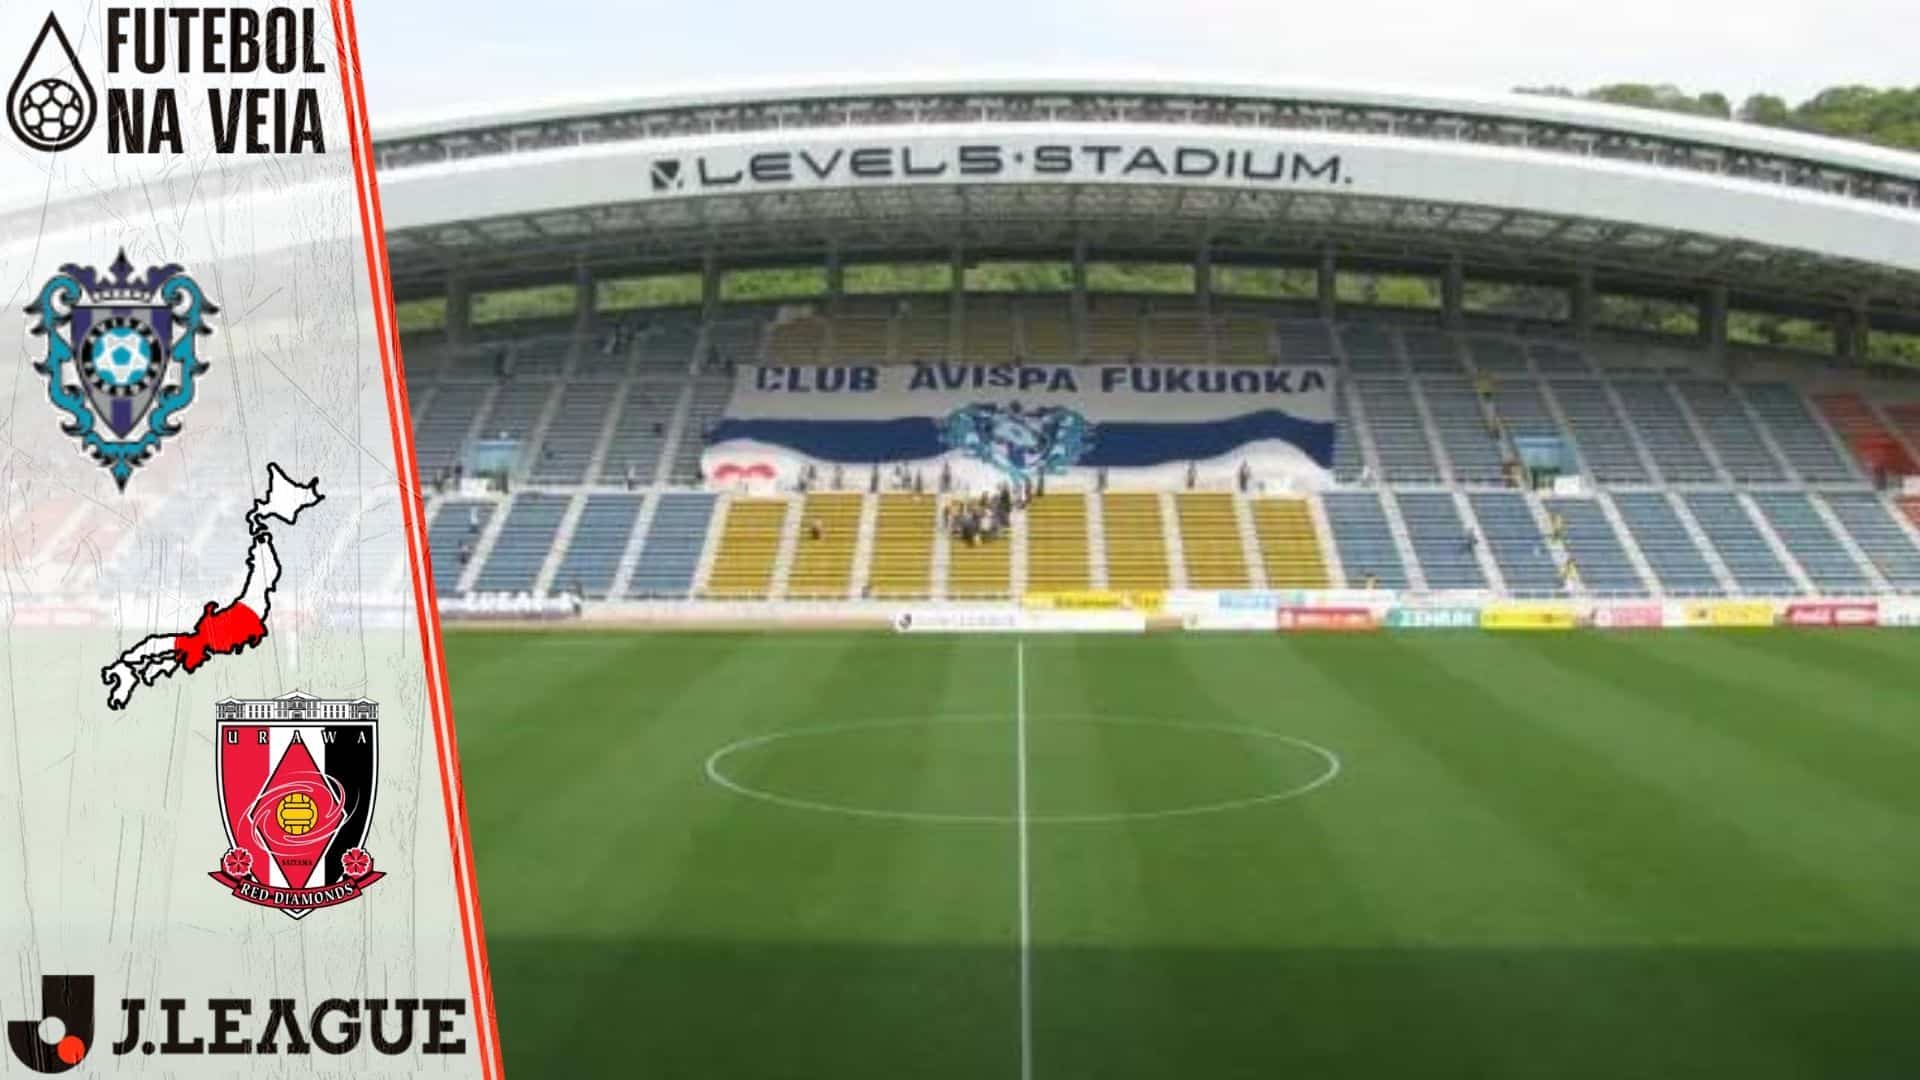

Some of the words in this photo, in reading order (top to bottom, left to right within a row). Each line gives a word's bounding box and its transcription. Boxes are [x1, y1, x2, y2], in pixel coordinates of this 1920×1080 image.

[755, 366, 879, 393] CLUB
[909, 362, 1078, 393] AVISPA
[1100, 366, 1326, 394] FUKUOKA
